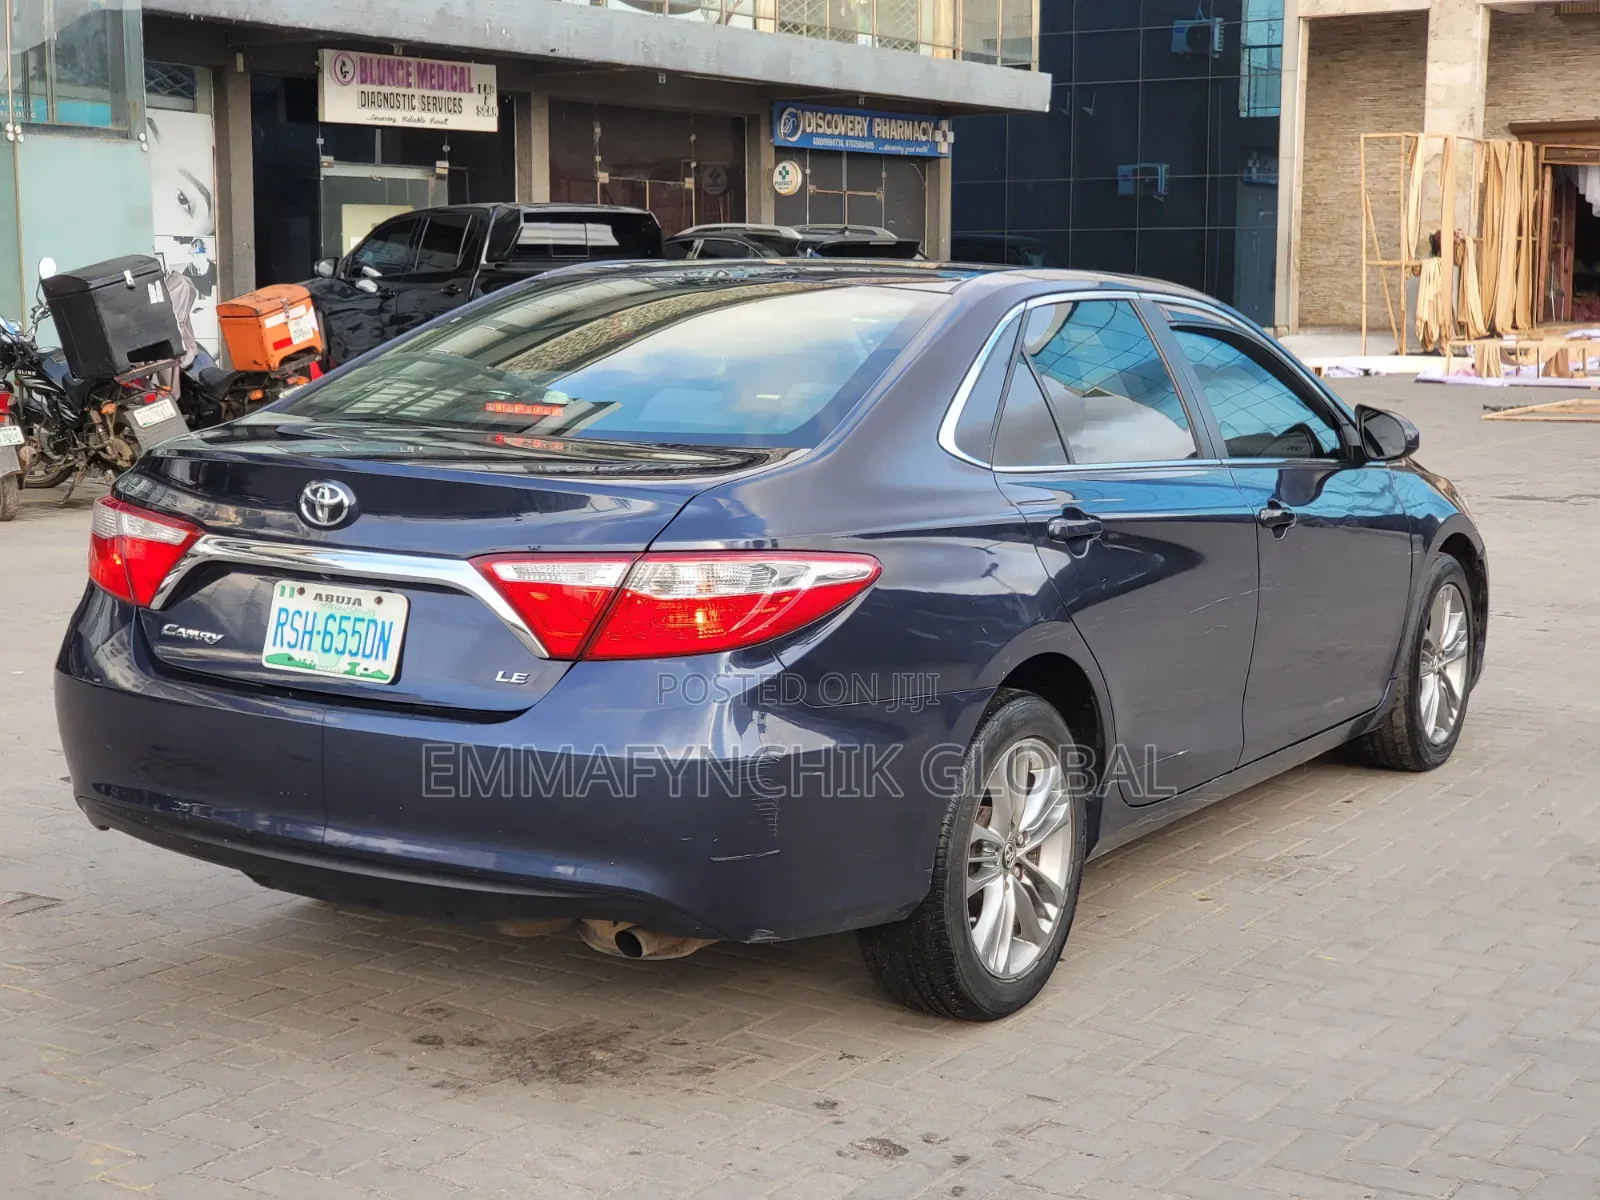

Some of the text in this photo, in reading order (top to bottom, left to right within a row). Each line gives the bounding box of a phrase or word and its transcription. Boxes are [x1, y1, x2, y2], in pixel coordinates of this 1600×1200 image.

[416, 61, 474, 93] MEDICAL
[359, 90, 463, 115] DIAGNOSTIC SERVICES
[804, 111, 934, 142] DISCOVERY PHARMACY
[313, 592, 363, 607] ABUJA
[161, 623, 225, 645] CAMRY
[272, 606, 394, 662] RSH-655DN
[495, 670, 531, 685] LE
